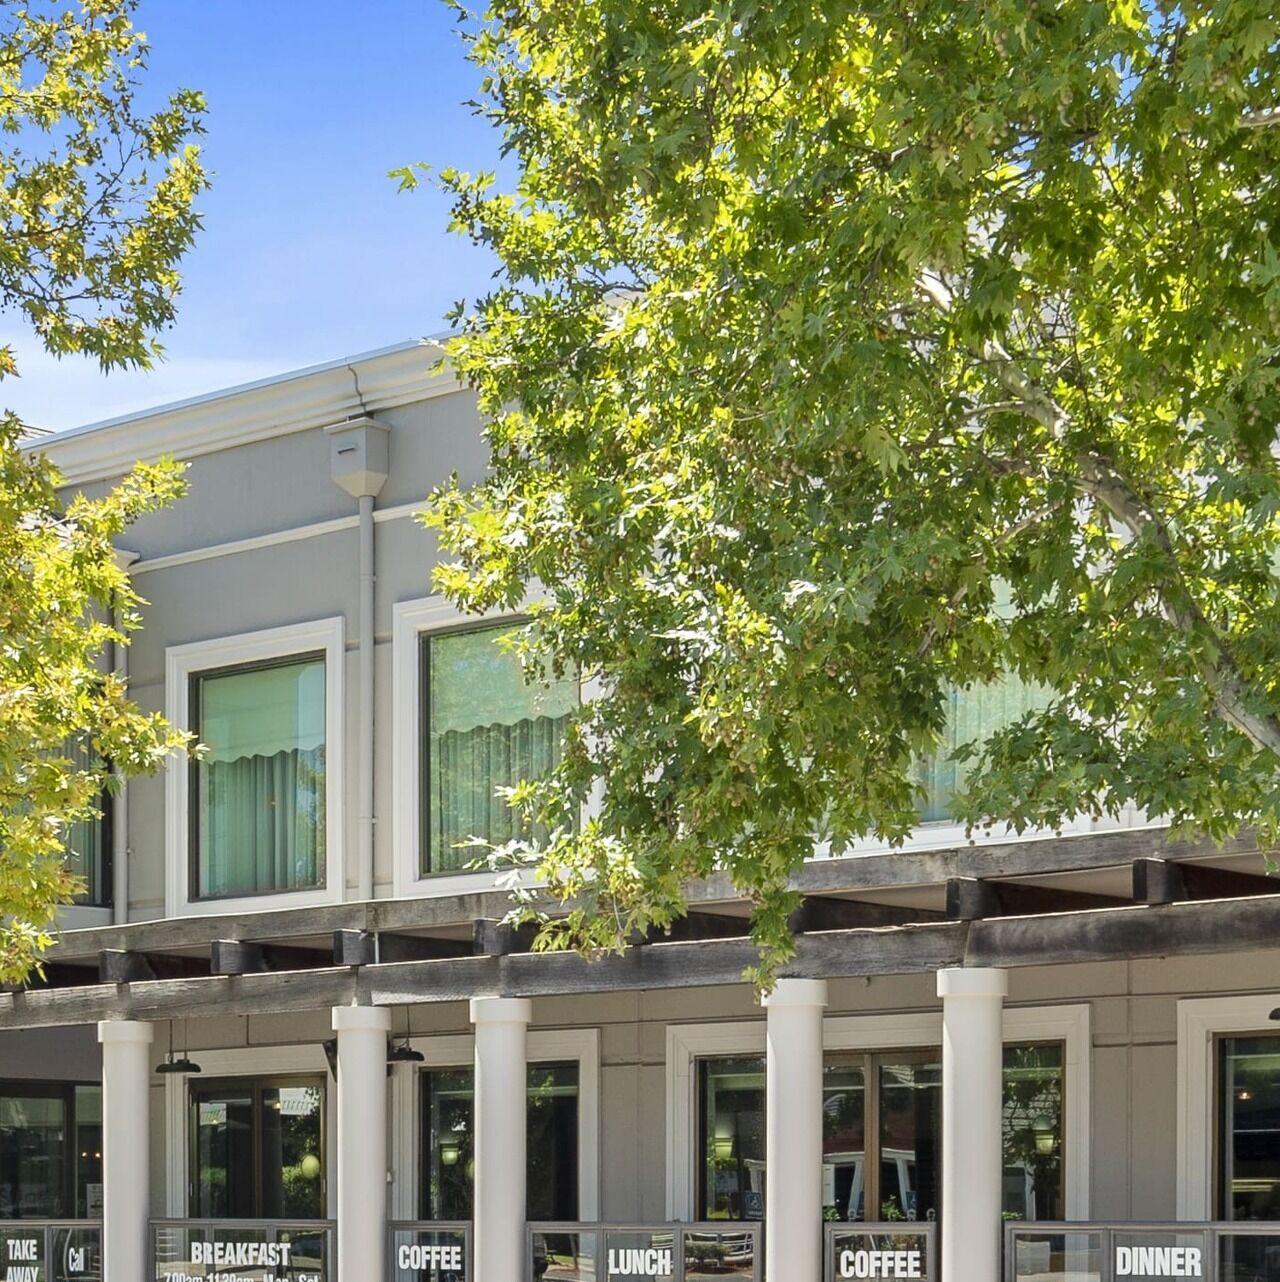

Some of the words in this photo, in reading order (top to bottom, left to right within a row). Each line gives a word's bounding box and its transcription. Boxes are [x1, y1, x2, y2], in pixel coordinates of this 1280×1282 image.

[7, 1239, 38, 1260] TAKE
[69, 1247, 85, 1271] Call
[191, 1241, 291, 1266] BREAKFAST
[398, 1244, 462, 1270] COFFEE
[608, 1248, 671, 1276] LUNCH
[1116, 1246, 1202, 1277] DINNER
[840, 1249, 921, 1279] COFFEE
